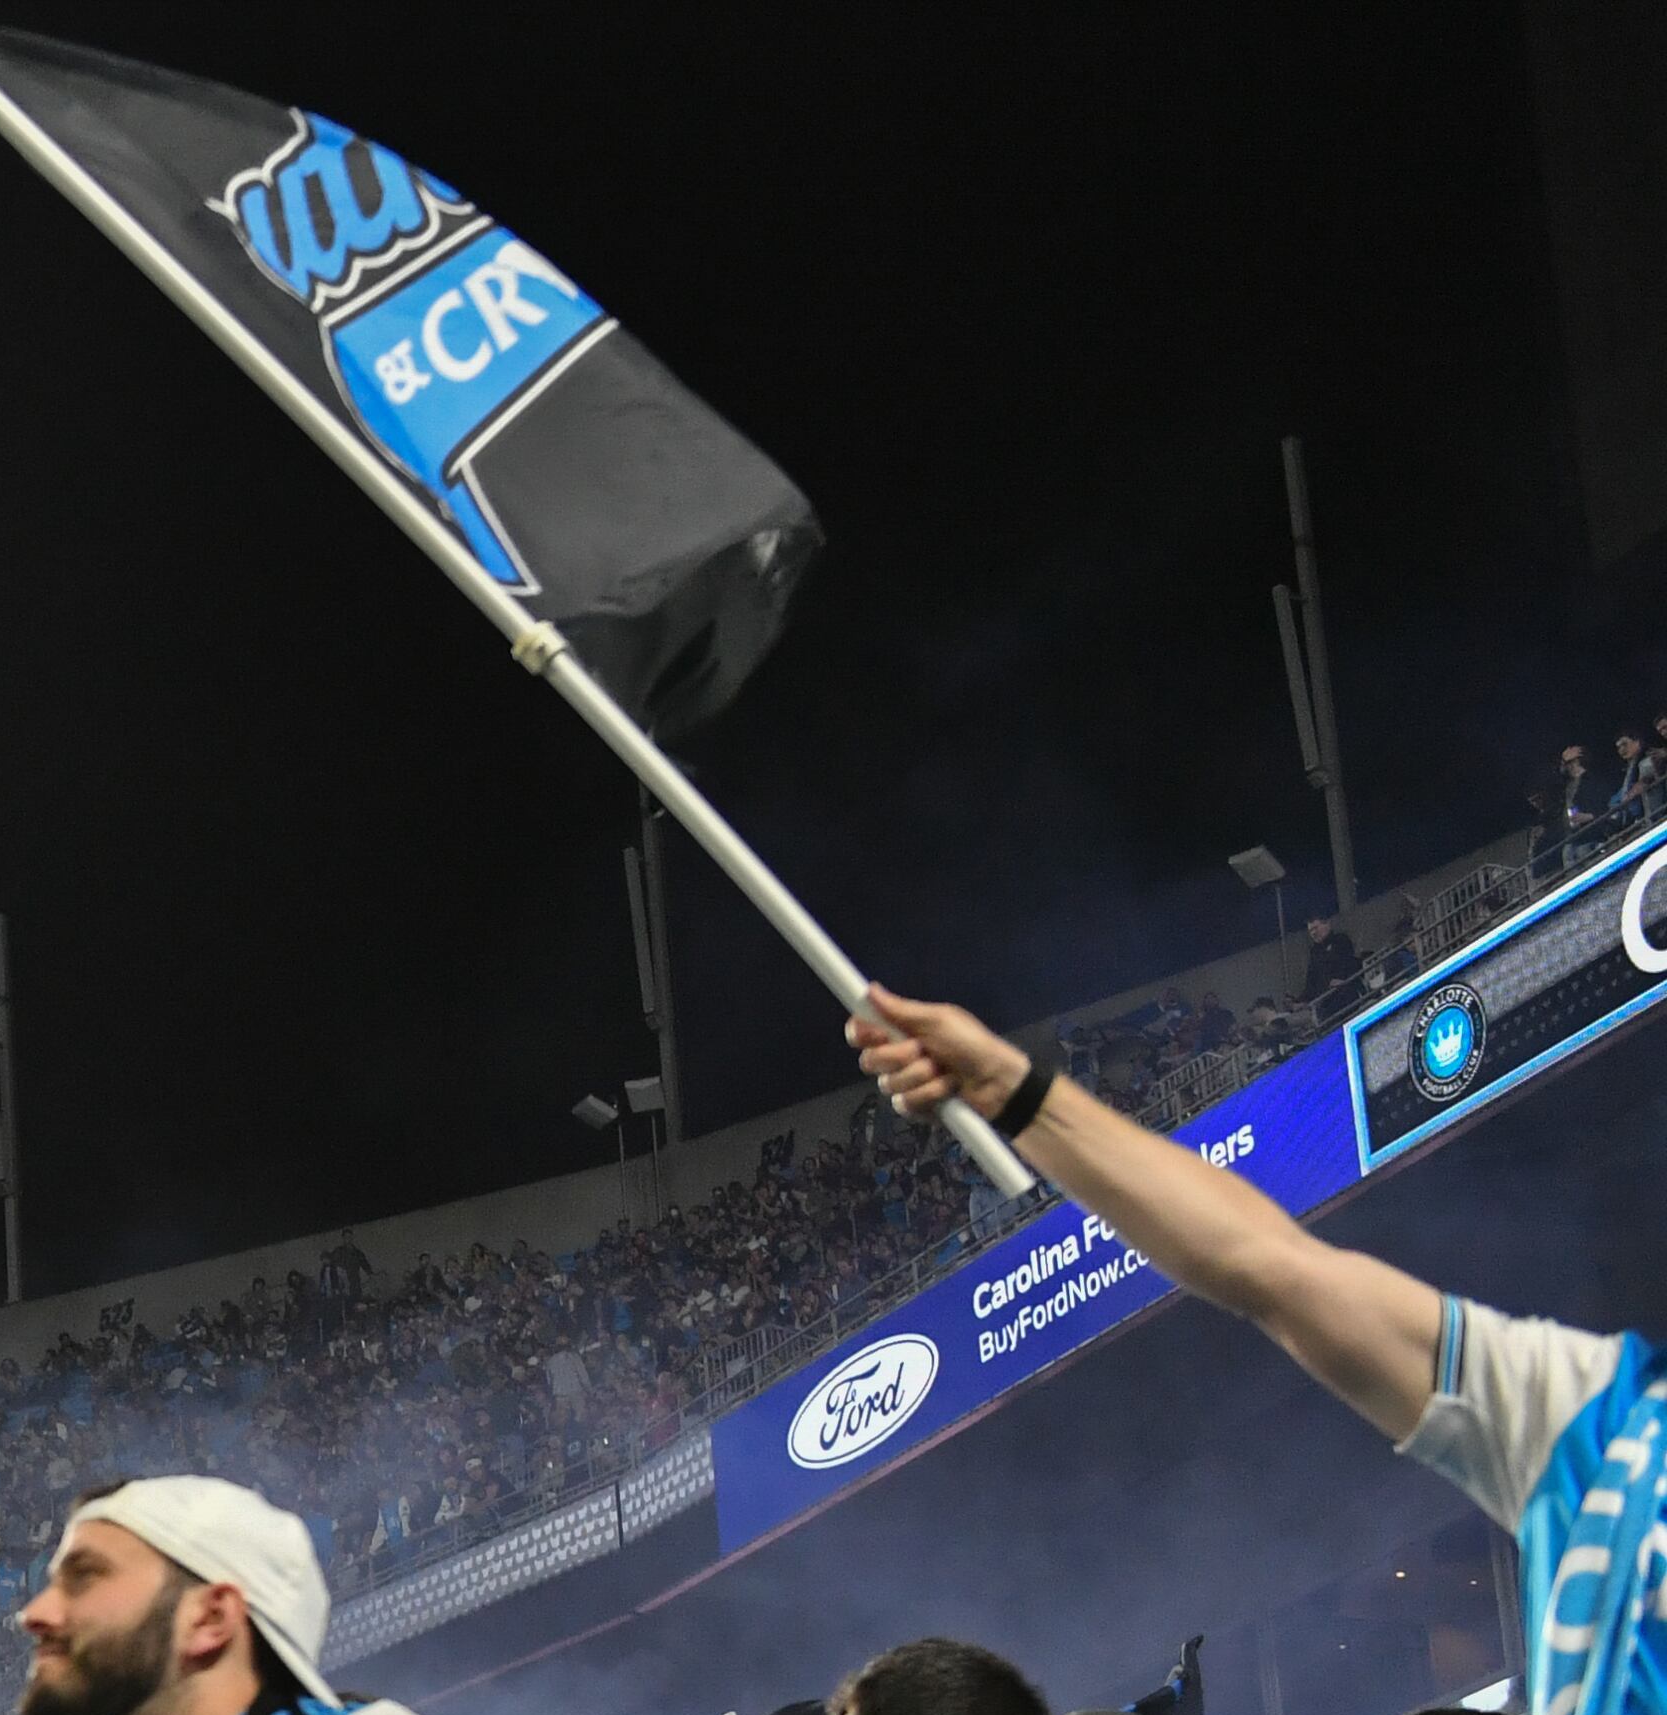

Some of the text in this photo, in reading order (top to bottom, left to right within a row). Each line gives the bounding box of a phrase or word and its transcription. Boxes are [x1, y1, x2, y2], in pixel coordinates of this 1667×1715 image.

[1416, 989, 1474, 1037] CHARLOTTE
[973, 1234, 1081, 1319] Carolina
[978, 1249, 1149, 1363] BuyFordNow.co
[819, 1360, 905, 1451] Ford
